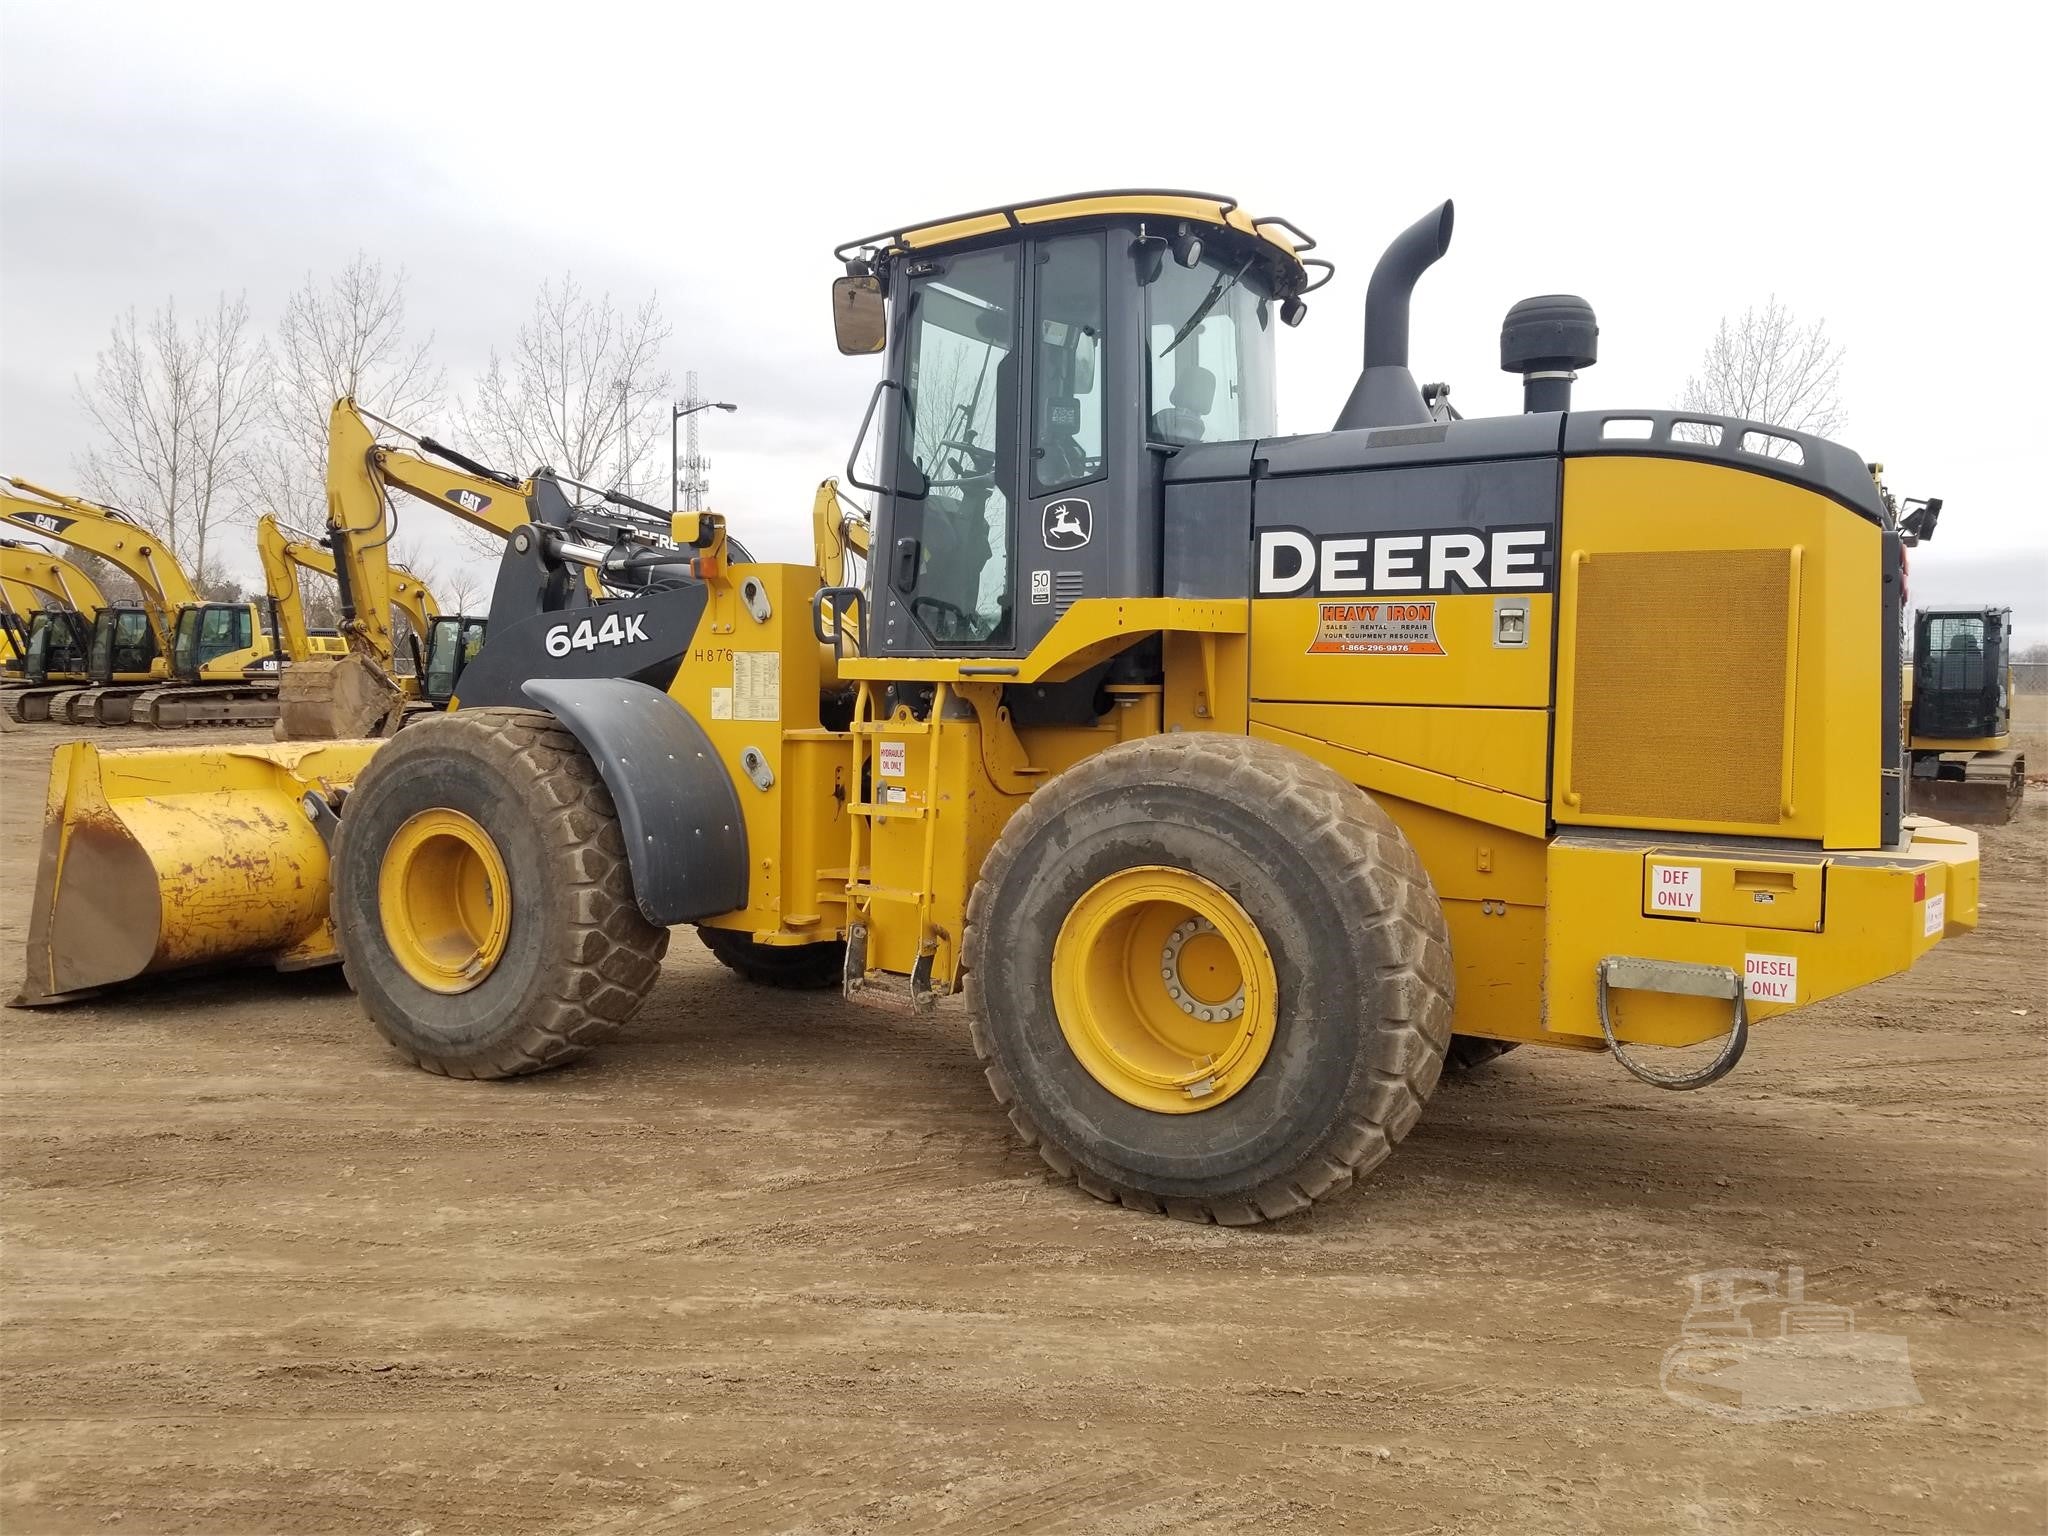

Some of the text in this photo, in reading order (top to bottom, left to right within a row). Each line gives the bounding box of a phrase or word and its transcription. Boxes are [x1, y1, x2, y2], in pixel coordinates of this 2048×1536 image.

[460, 490, 481, 512] CAT
[35, 514, 59, 531] CAT
[1259, 530, 1546, 593] DEERE
[1033, 573, 1049, 588] 50
[1322, 605, 1431, 621] HEAVY IRON
[545, 613, 649, 657] 644K
[263, 660, 278, 670] CAT
[1663, 870, 1689, 885] DEF
[1658, 891, 1694, 907] ONLY
[1746, 959, 1795, 977] DIESEL
[1752, 981, 1788, 997] ONLY
